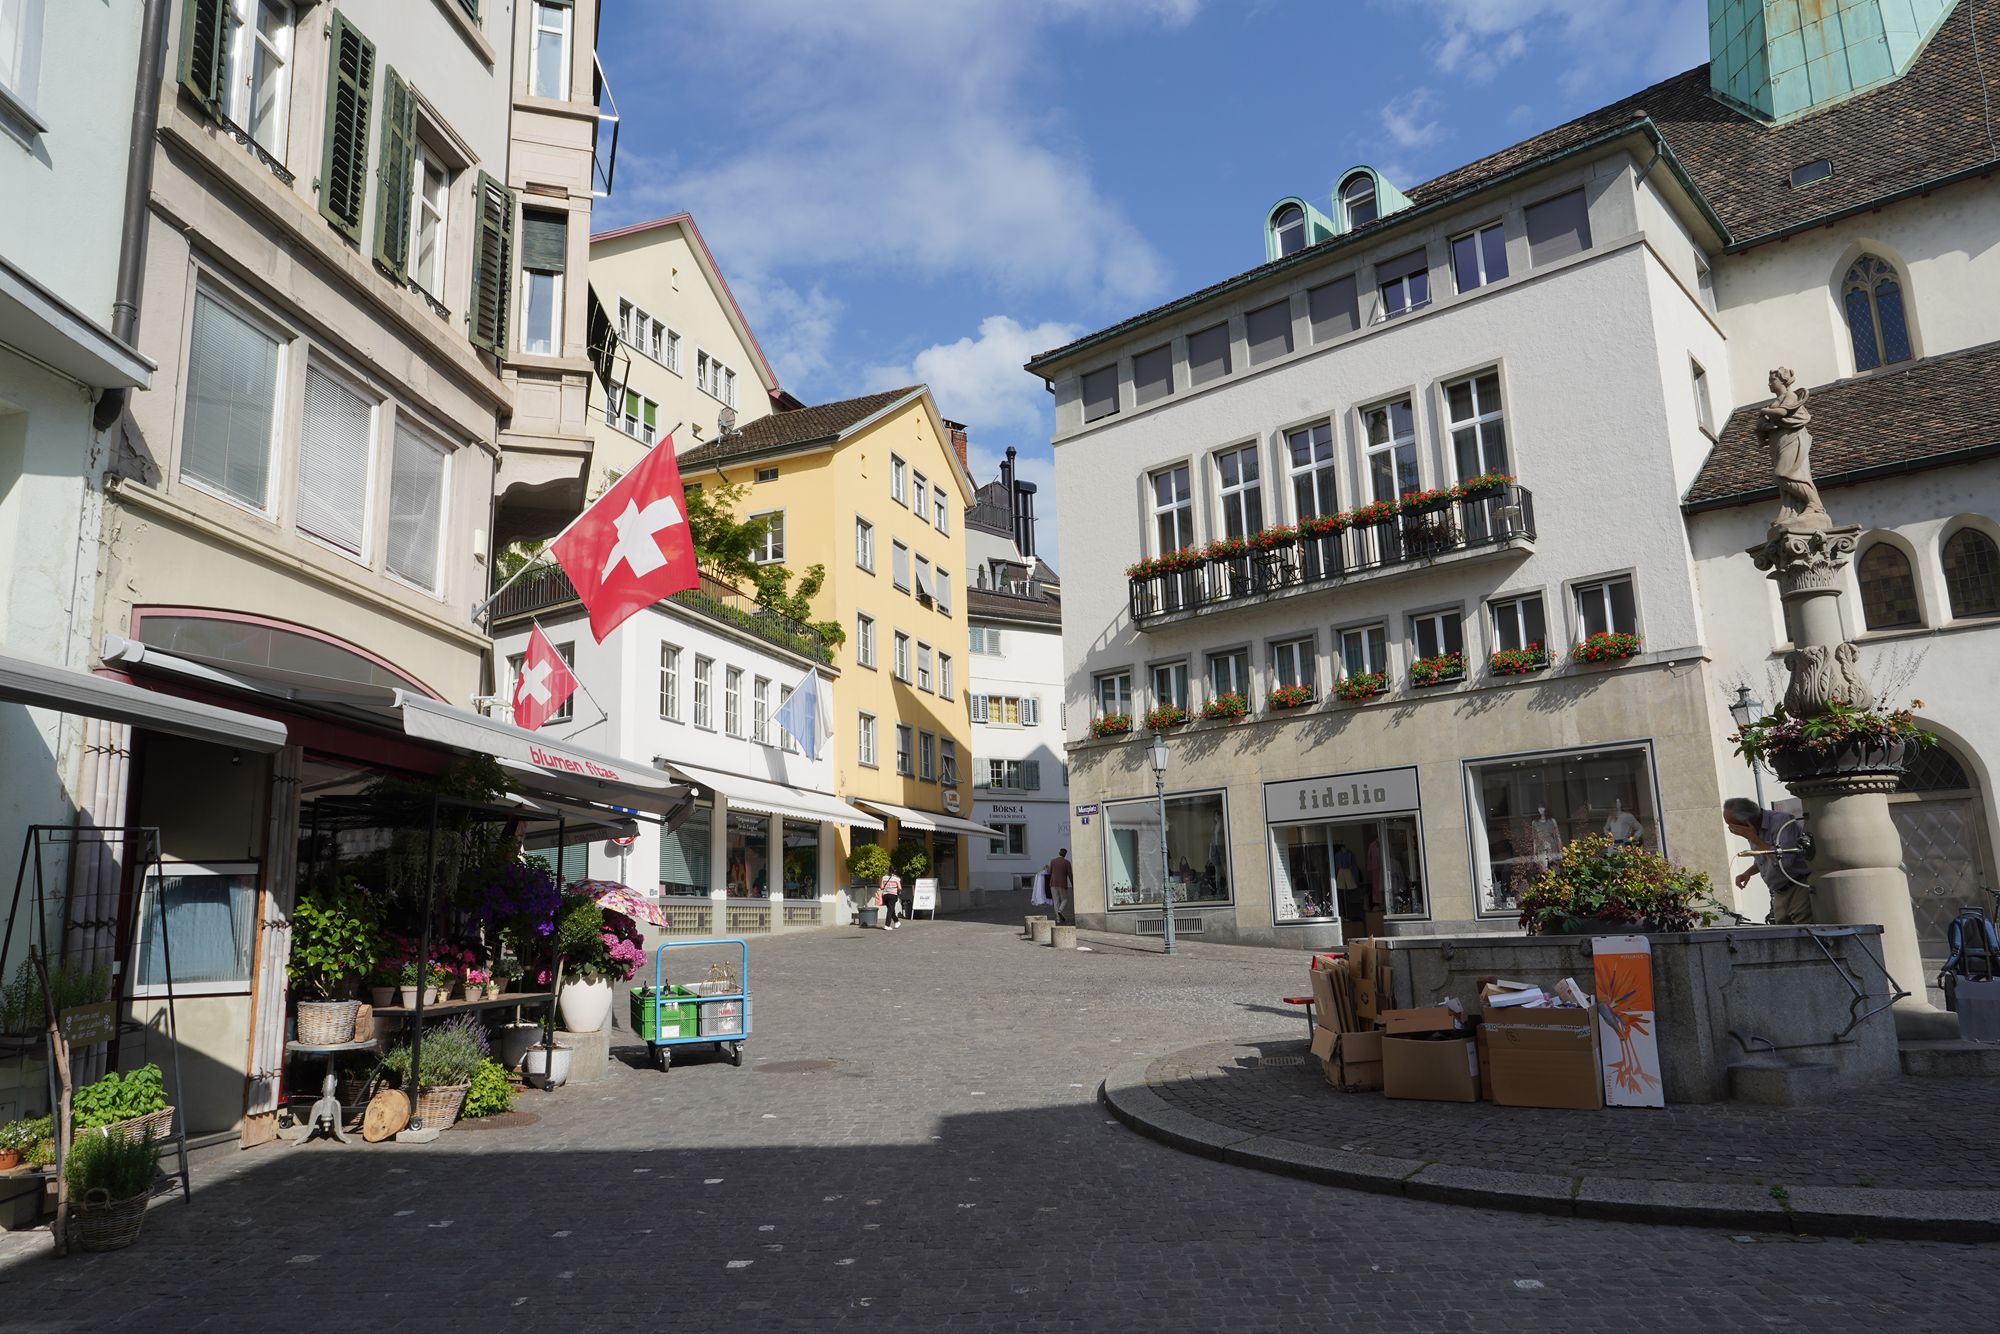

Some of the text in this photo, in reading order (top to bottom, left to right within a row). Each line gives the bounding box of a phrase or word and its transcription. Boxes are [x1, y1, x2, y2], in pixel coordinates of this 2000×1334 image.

[529, 746, 620, 780] blumen fitze
[992, 803, 1024, 813] BÖRSE 4
[1298, 784, 1386, 810] fidelio
